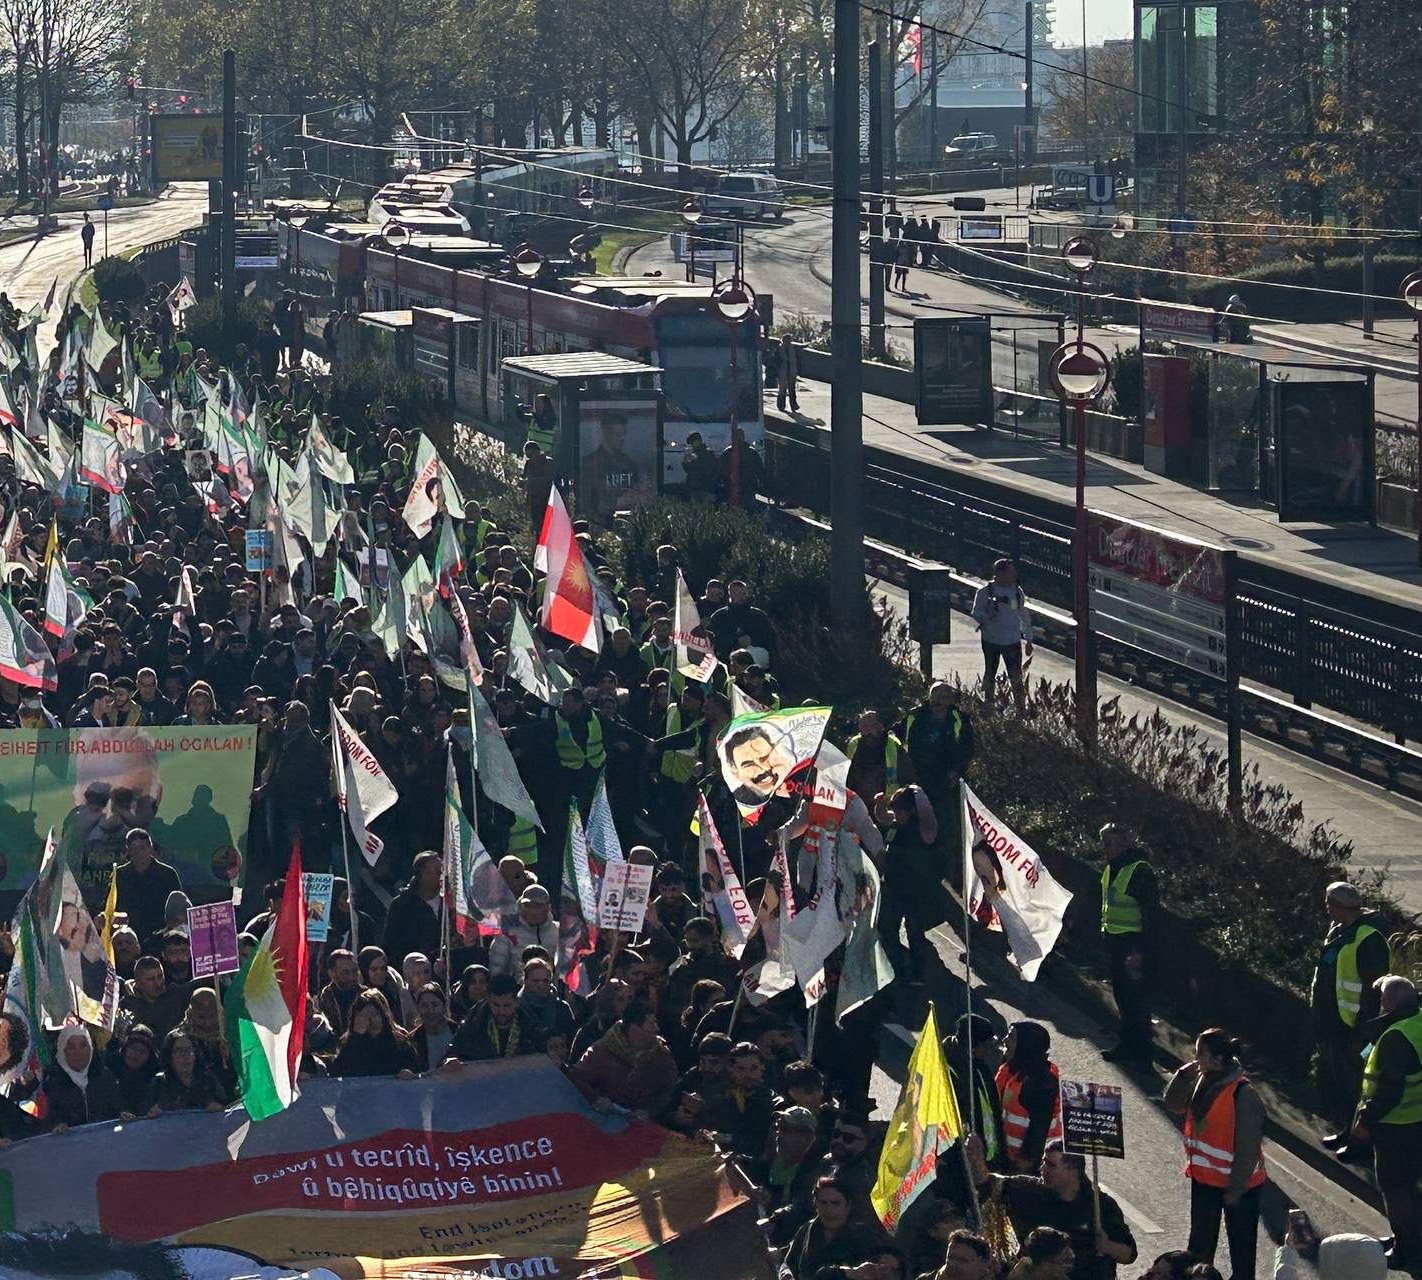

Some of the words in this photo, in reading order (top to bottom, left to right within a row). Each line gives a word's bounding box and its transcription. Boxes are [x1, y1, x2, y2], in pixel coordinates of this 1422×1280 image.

[1089, 176, 1112, 202] U
[351, 1143, 440, 1171] tecrîd,
[445, 1136, 554, 1171] îşkence
[302, 1177, 319, 1196] û
[327, 1176, 476, 1203] bêhiqûqiyê
[485, 1166, 563, 1194] bînin!
